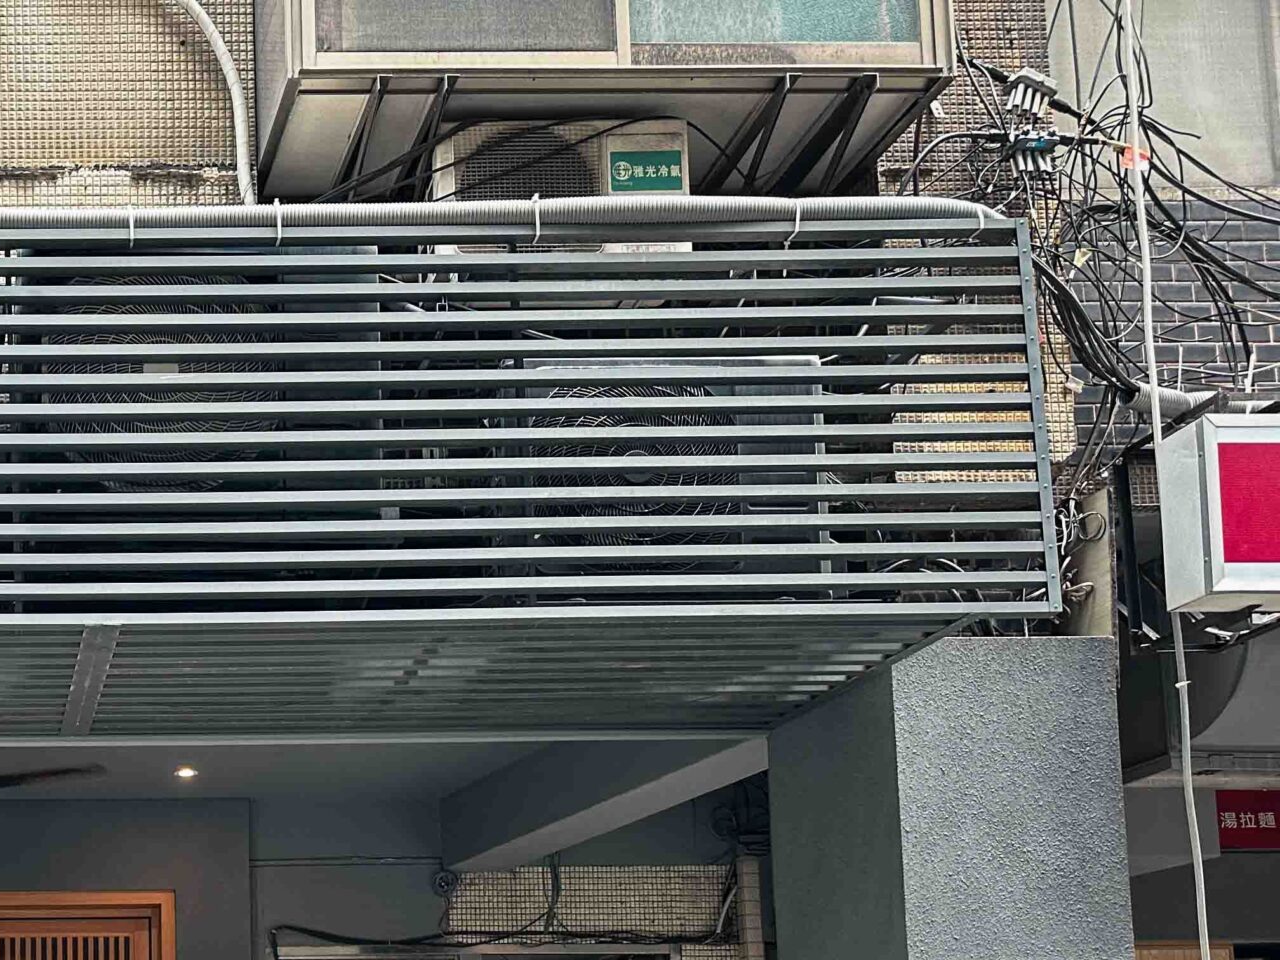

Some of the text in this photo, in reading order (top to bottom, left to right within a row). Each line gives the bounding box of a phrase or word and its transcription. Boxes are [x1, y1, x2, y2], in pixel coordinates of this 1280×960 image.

[632, 165, 681, 178] 雅光冷氣
[1219, 811, 1277, 829] 湯拉麵
